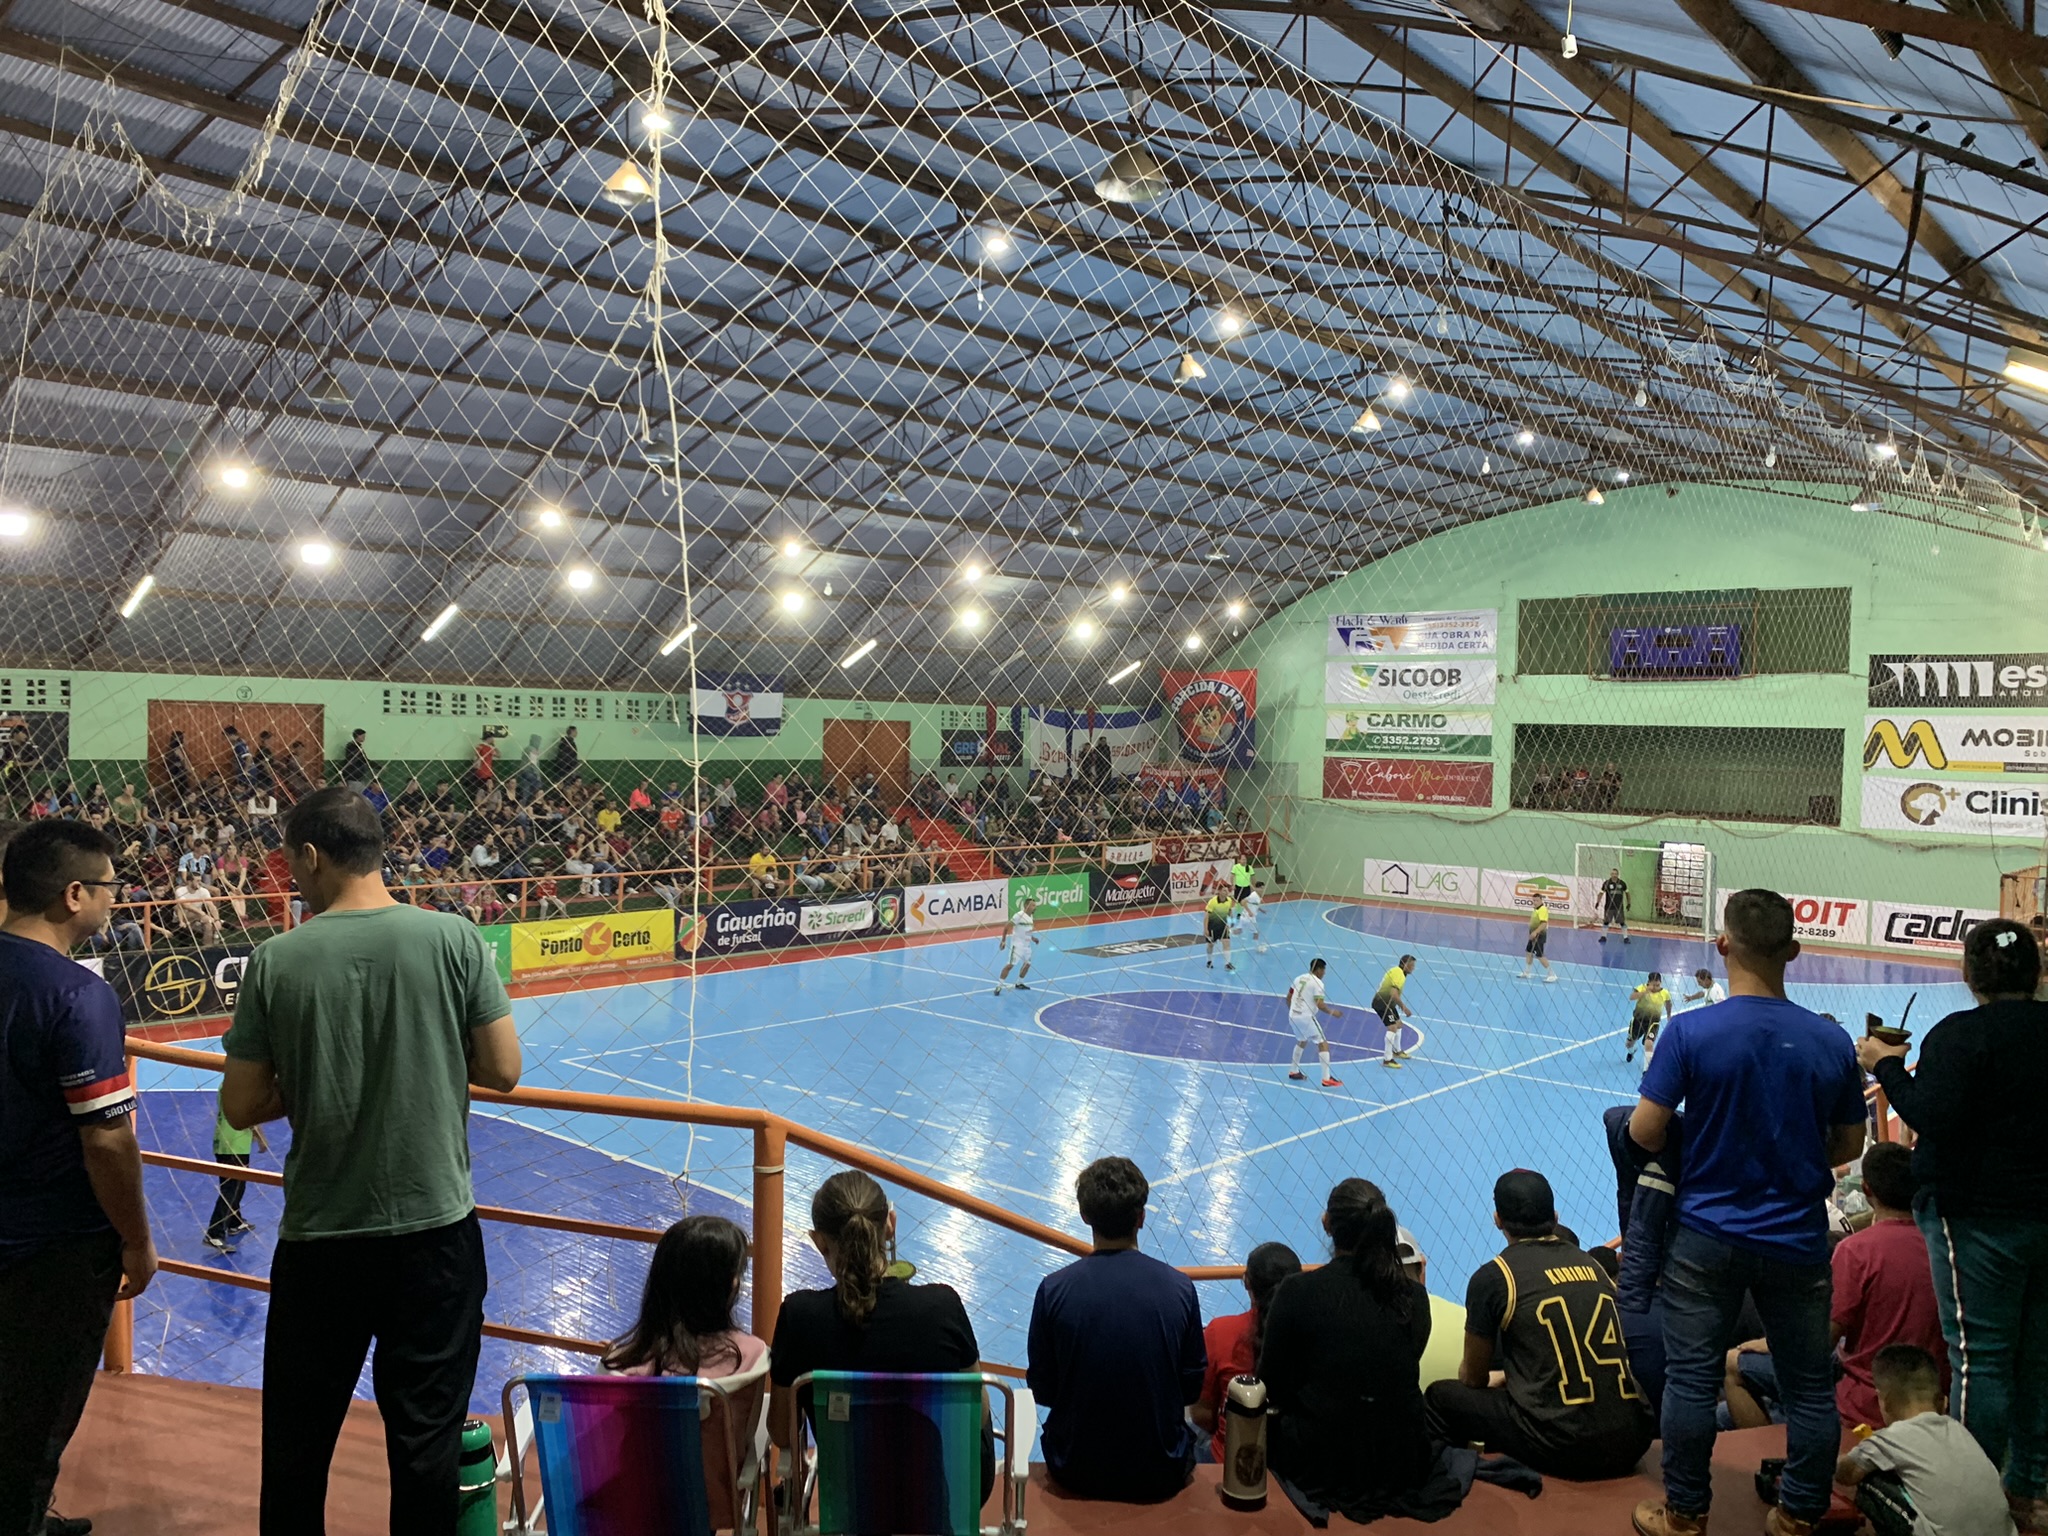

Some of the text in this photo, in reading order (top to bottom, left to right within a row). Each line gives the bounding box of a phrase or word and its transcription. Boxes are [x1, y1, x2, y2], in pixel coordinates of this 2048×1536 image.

[1442, 631, 1470, 639] OBRA
[1474, 630, 1489, 638] NA
[1457, 641, 1488, 649] CERTA
[1378, 668, 1461, 687] SICOOB
[1366, 713, 1447, 729] CARMO
[1382, 735, 1440, 746] 3352.2793
[1171, 871, 1198, 882] MAX
[1415, 869, 1459, 892] LAG
[928, 888, 1004, 916] CAMBAÍ
[1035, 883, 1083, 906] Sicredi
[716, 907, 796, 933] Gauchão
[825, 908, 867, 926] Sicredi
[541, 930, 651, 956] Ponto Certo
[717, 931, 762, 947] de futsal
[104, 1105, 123, 1119] SÃO
[1536, 1293, 1639, 1405] 14
